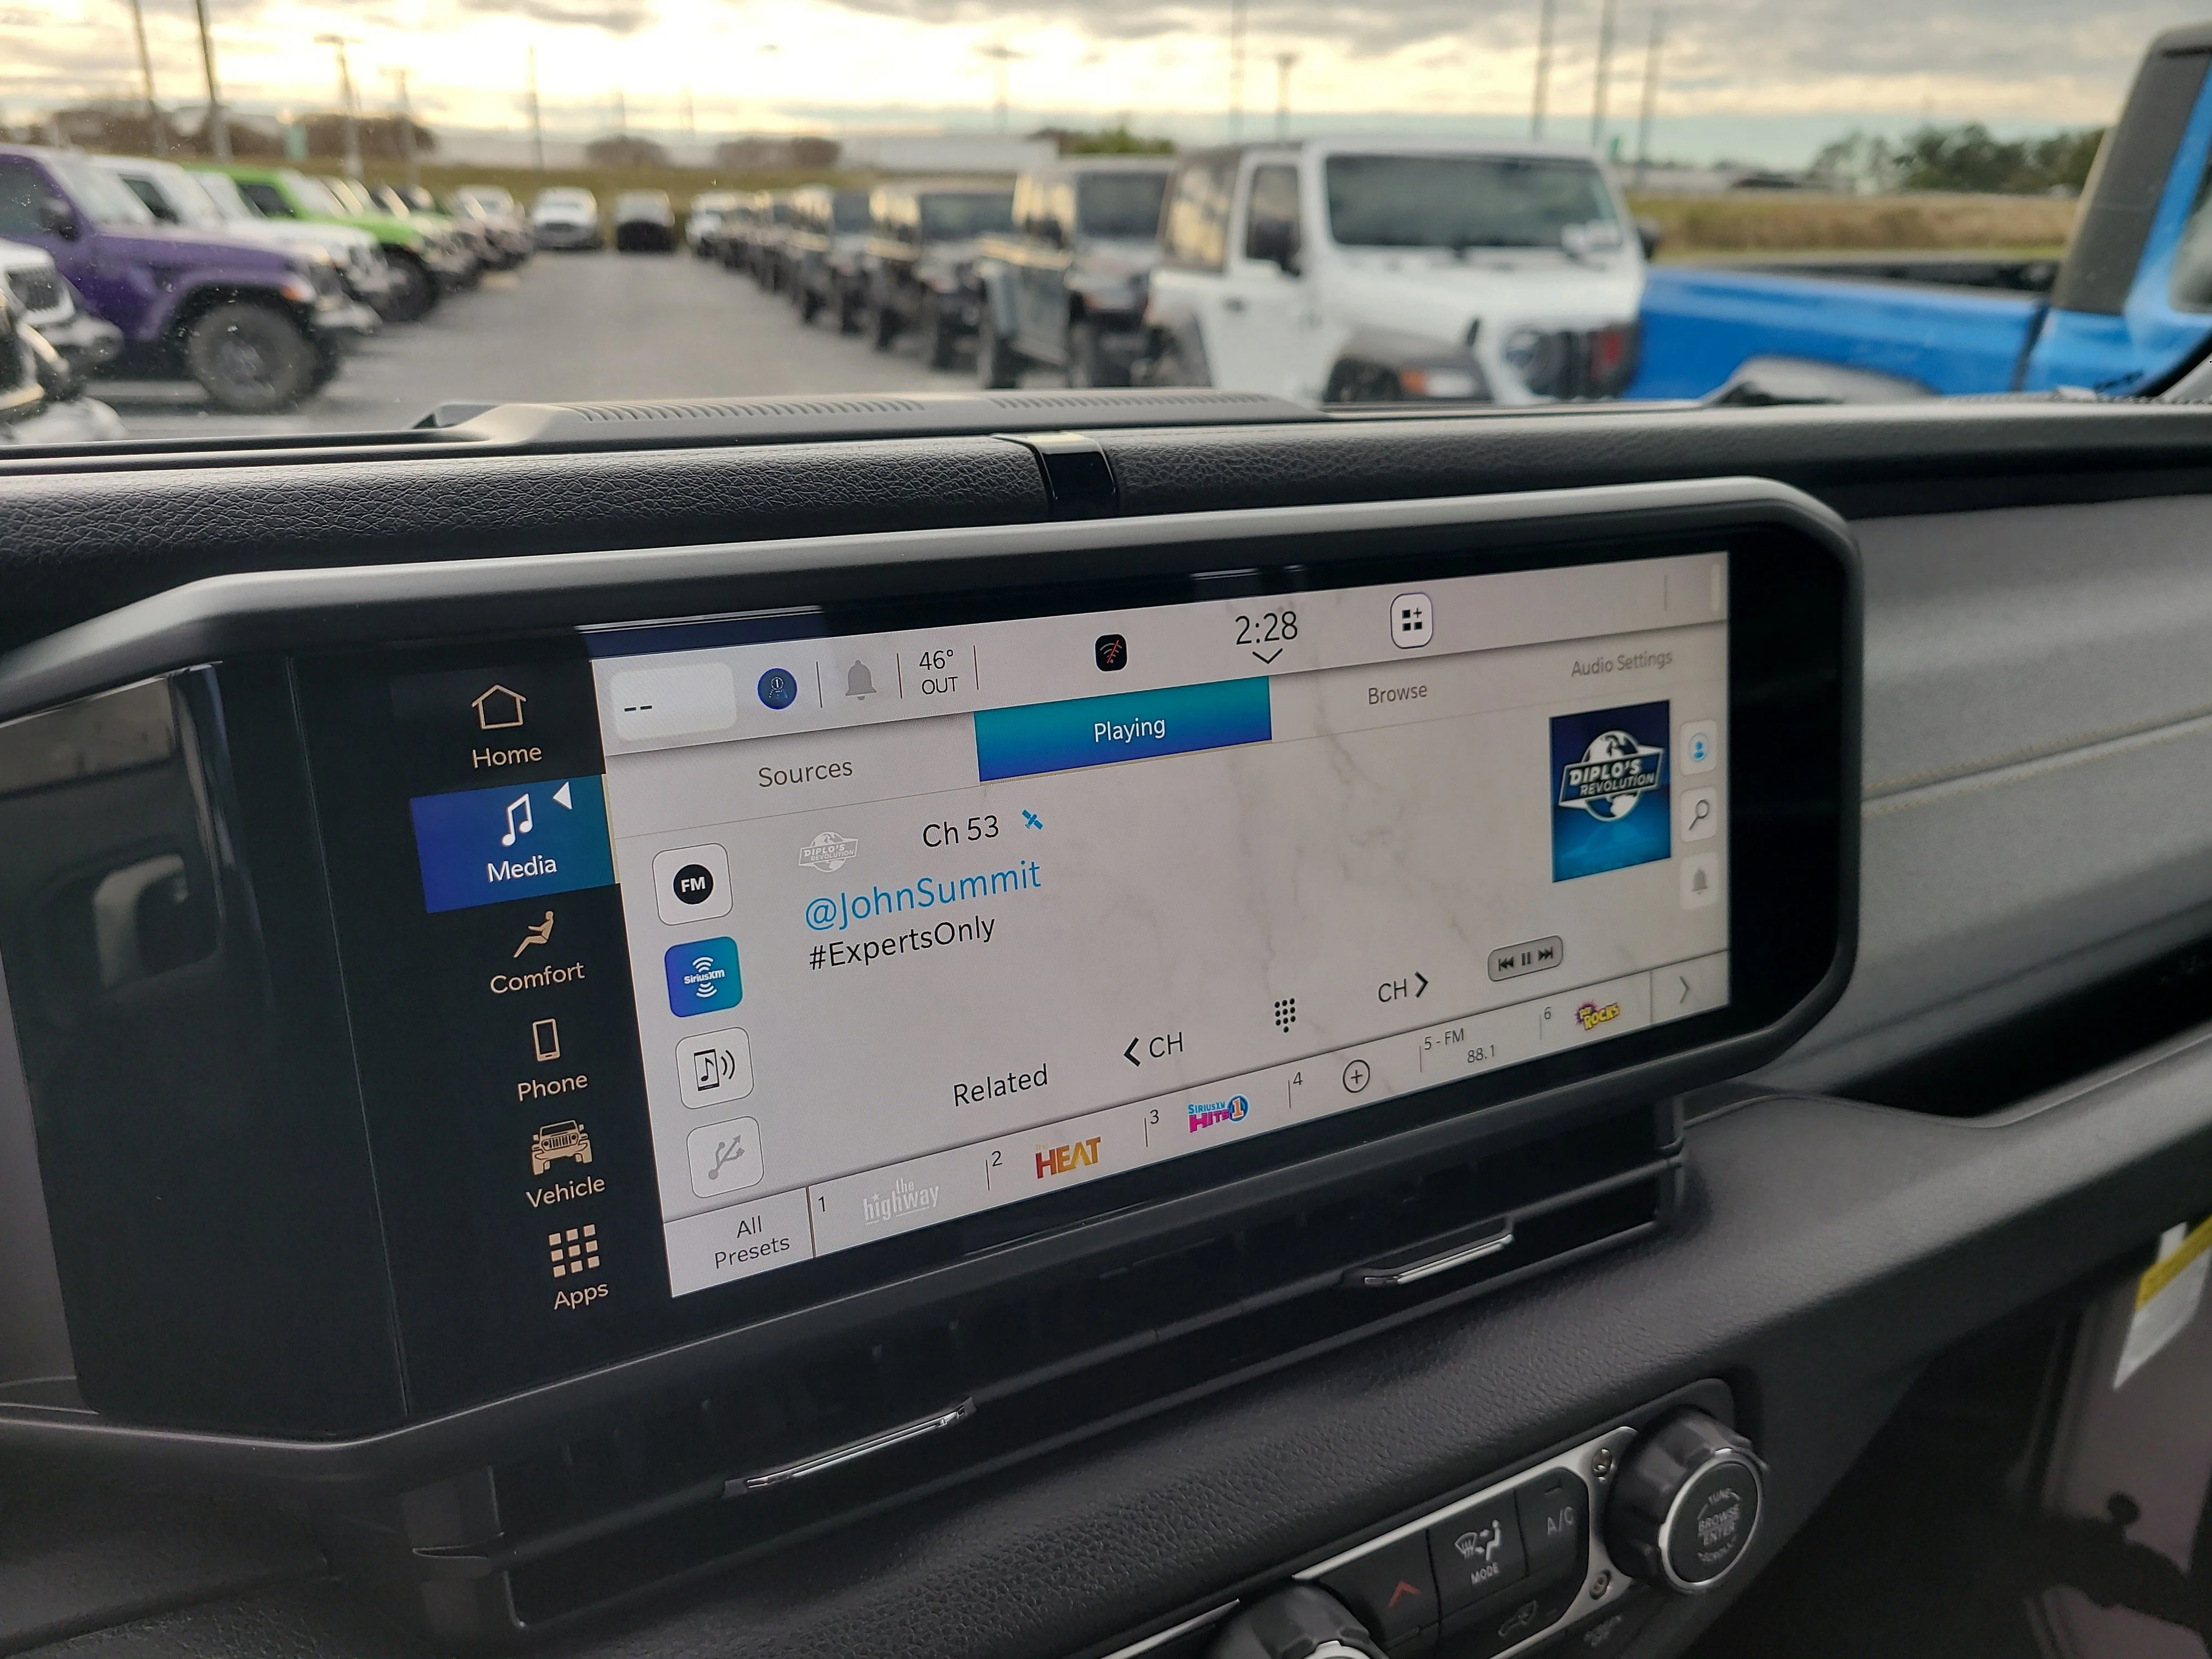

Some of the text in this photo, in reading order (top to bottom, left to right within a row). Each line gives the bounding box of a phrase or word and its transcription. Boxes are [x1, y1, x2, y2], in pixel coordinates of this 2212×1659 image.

[1235, 611, 1299, 645] 2:28
[919, 649, 955, 671] 46°
[1571, 650, 1672, 678] Audio Settings
[921, 676, 958, 695] OUT
[1368, 682, 1427, 705] Browse
[1094, 717, 1166, 743] Playing
[472, 745, 543, 769] Home
[759, 760, 854, 788] Sources
[1569, 758, 1641, 786] DIPLO'S
[1580, 773, 1655, 796] REVOLUTION
[923, 815, 999, 847] Ch 53
[804, 844, 845, 857] DIPLO'S
[810, 849, 854, 861] REVOLUTION
[487, 856, 557, 883] Media
[680, 876, 706, 893] FM
[806, 860, 1041, 931] @JohnSummit
[810, 915, 996, 970] #ExpertsOnly
[490, 962, 585, 994] Comfort
[1378, 979, 1407, 1002] CH
[1543, 1007, 1551, 1020] 6
[1149, 1032, 1184, 1058] CH
[1424, 1036, 1432, 1051] 5
[1444, 1028, 1464, 1047] FM
[1467, 1045, 1495, 1063] 88.1
[517, 1073, 588, 1102] Phone
[955, 1063, 1049, 1107] Related
[1293, 1071, 1303, 1086] 4
[1150, 1110, 1159, 1124] 3
[1189, 1097, 1244, 1133] HITS 1
[992, 1150, 1003, 1166] 2
[1035, 1136, 1101, 1179] HEAT
[526, 1176, 606, 1207] Vehicle
[818, 1197, 827, 1212] 1
[864, 1185, 939, 1220] highway
[736, 1215, 762, 1238] All
[715, 1235, 790, 1269] Presets
[554, 1282, 608, 1310] Apps
[1547, 1506, 1574, 1535] A/C
[1471, 1562, 1499, 1585] MODE
